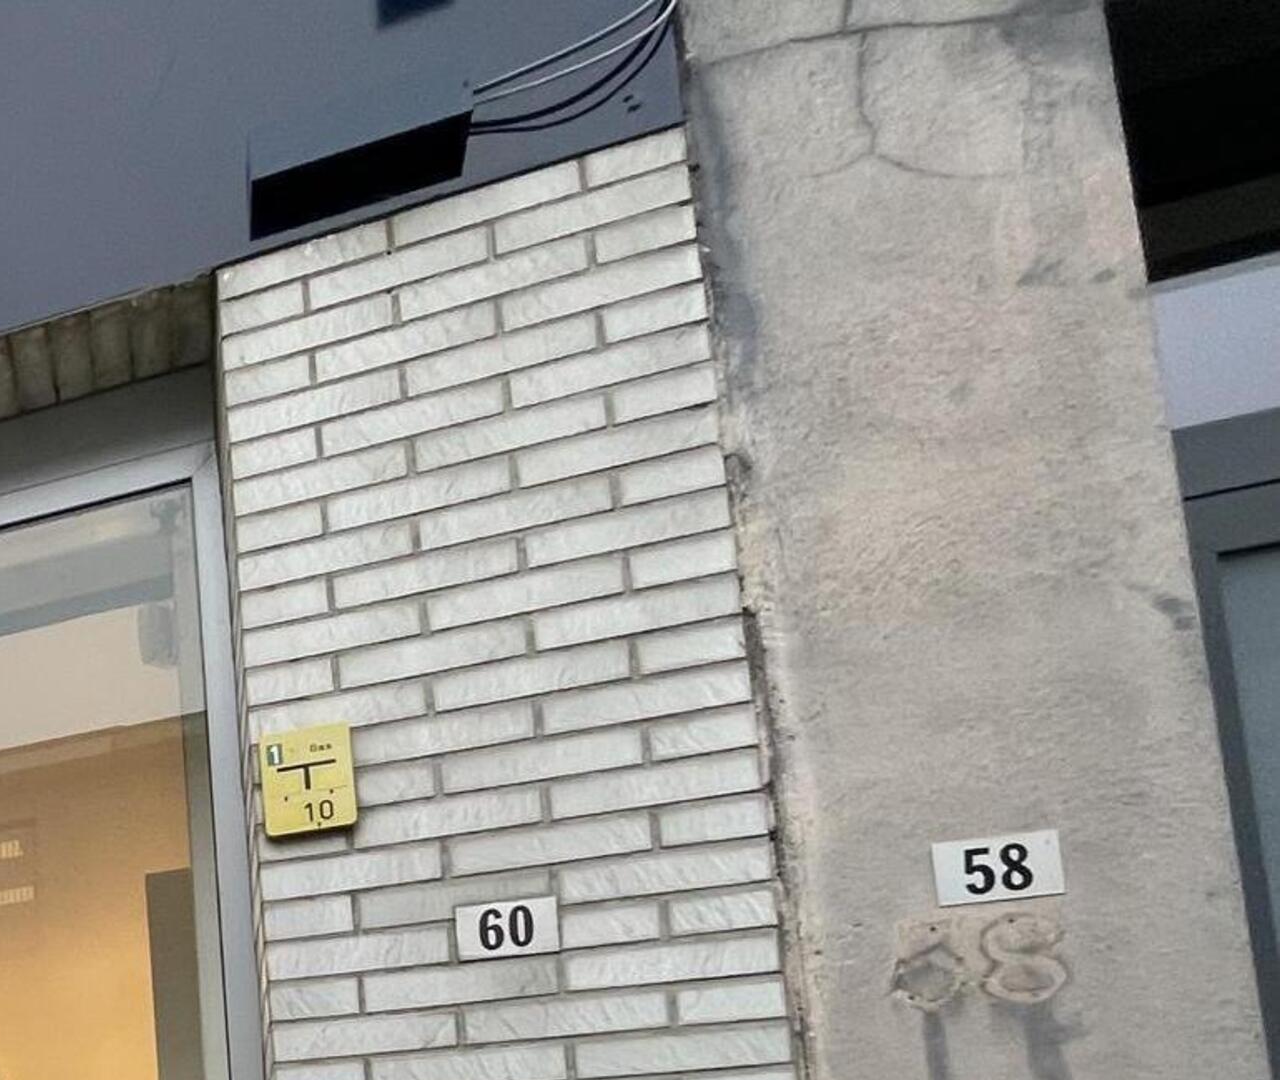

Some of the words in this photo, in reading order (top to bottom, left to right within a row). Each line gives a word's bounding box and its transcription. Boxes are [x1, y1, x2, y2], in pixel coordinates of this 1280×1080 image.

[303, 799, 335, 822] 10
[962, 843, 1034, 895] 58
[478, 904, 535, 951] 60
